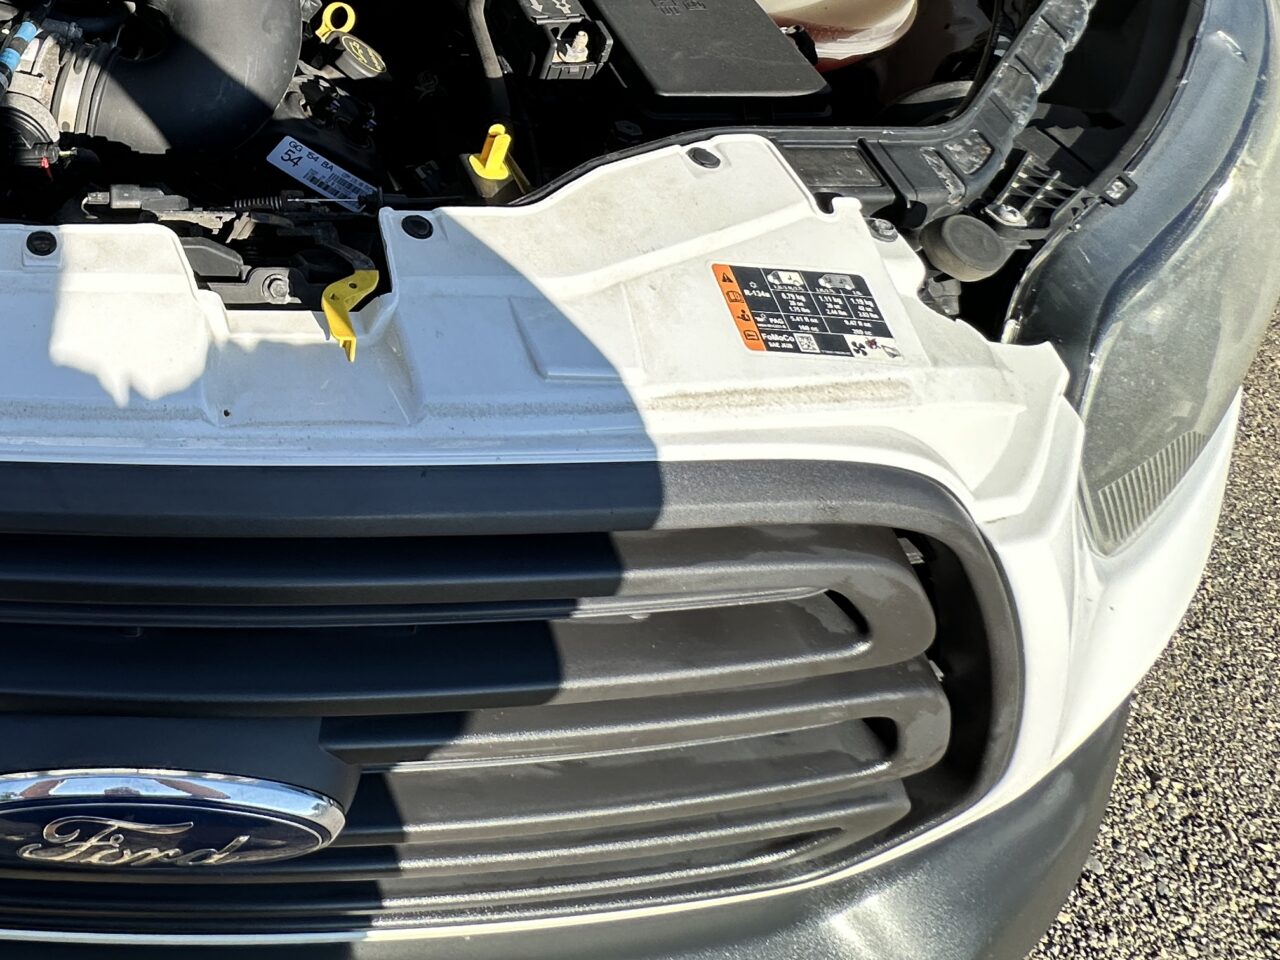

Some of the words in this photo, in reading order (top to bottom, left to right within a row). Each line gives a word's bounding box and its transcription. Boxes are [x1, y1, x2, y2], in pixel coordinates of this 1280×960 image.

[280, 149, 303, 167] 54
[289, 140, 303, 153] GG
[320, 160, 334, 172] BA
[743, 289, 770, 298] R-134a
[761, 332, 795, 342] FoMoCo
[19, 816, 250, 866] Ford
